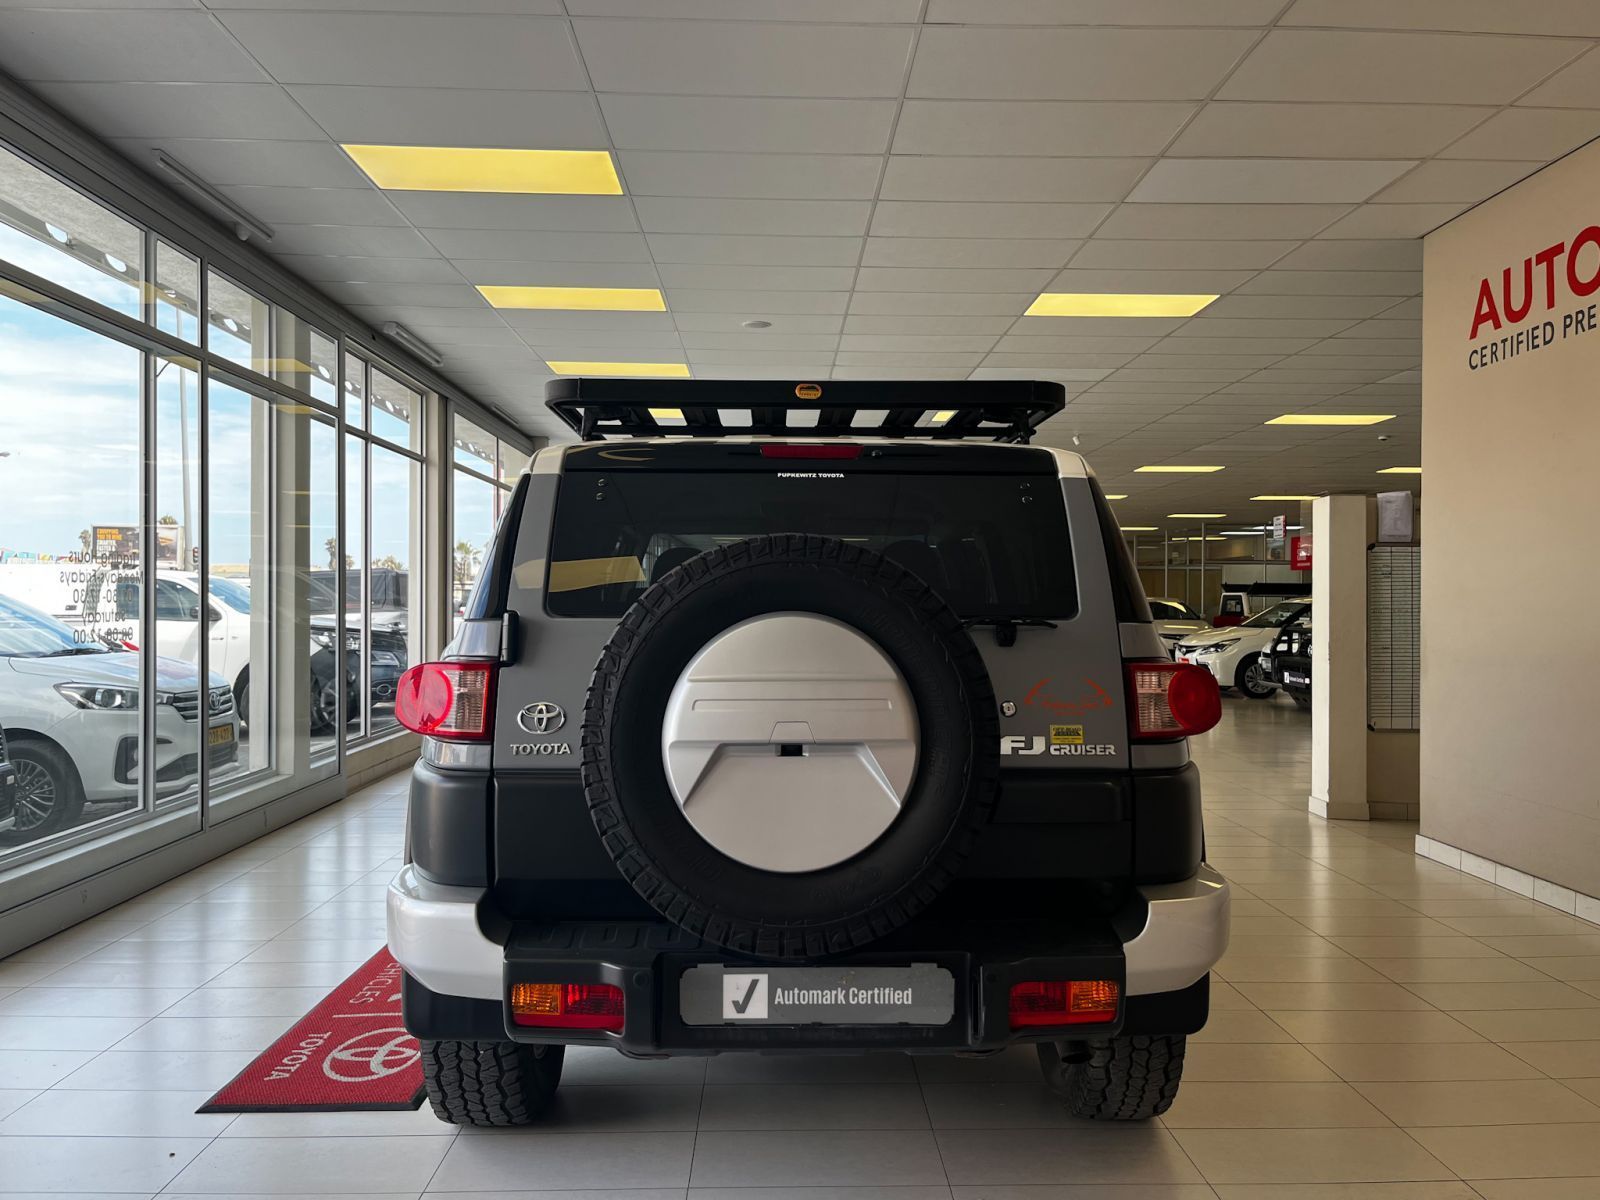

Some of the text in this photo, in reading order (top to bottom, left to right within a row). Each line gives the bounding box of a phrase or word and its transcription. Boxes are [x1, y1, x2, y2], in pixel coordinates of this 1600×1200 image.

[1469, 226, 1600, 340] AUTO
[1469, 304, 1597, 370] CERTIFIED PRE
[510, 743, 571, 755] TOYOTA
[1000, 736, 1116, 755] FJ CRUISER
[774, 987, 912, 1005] Automark Certified
[263, 1031, 332, 1082] TOYOTA
